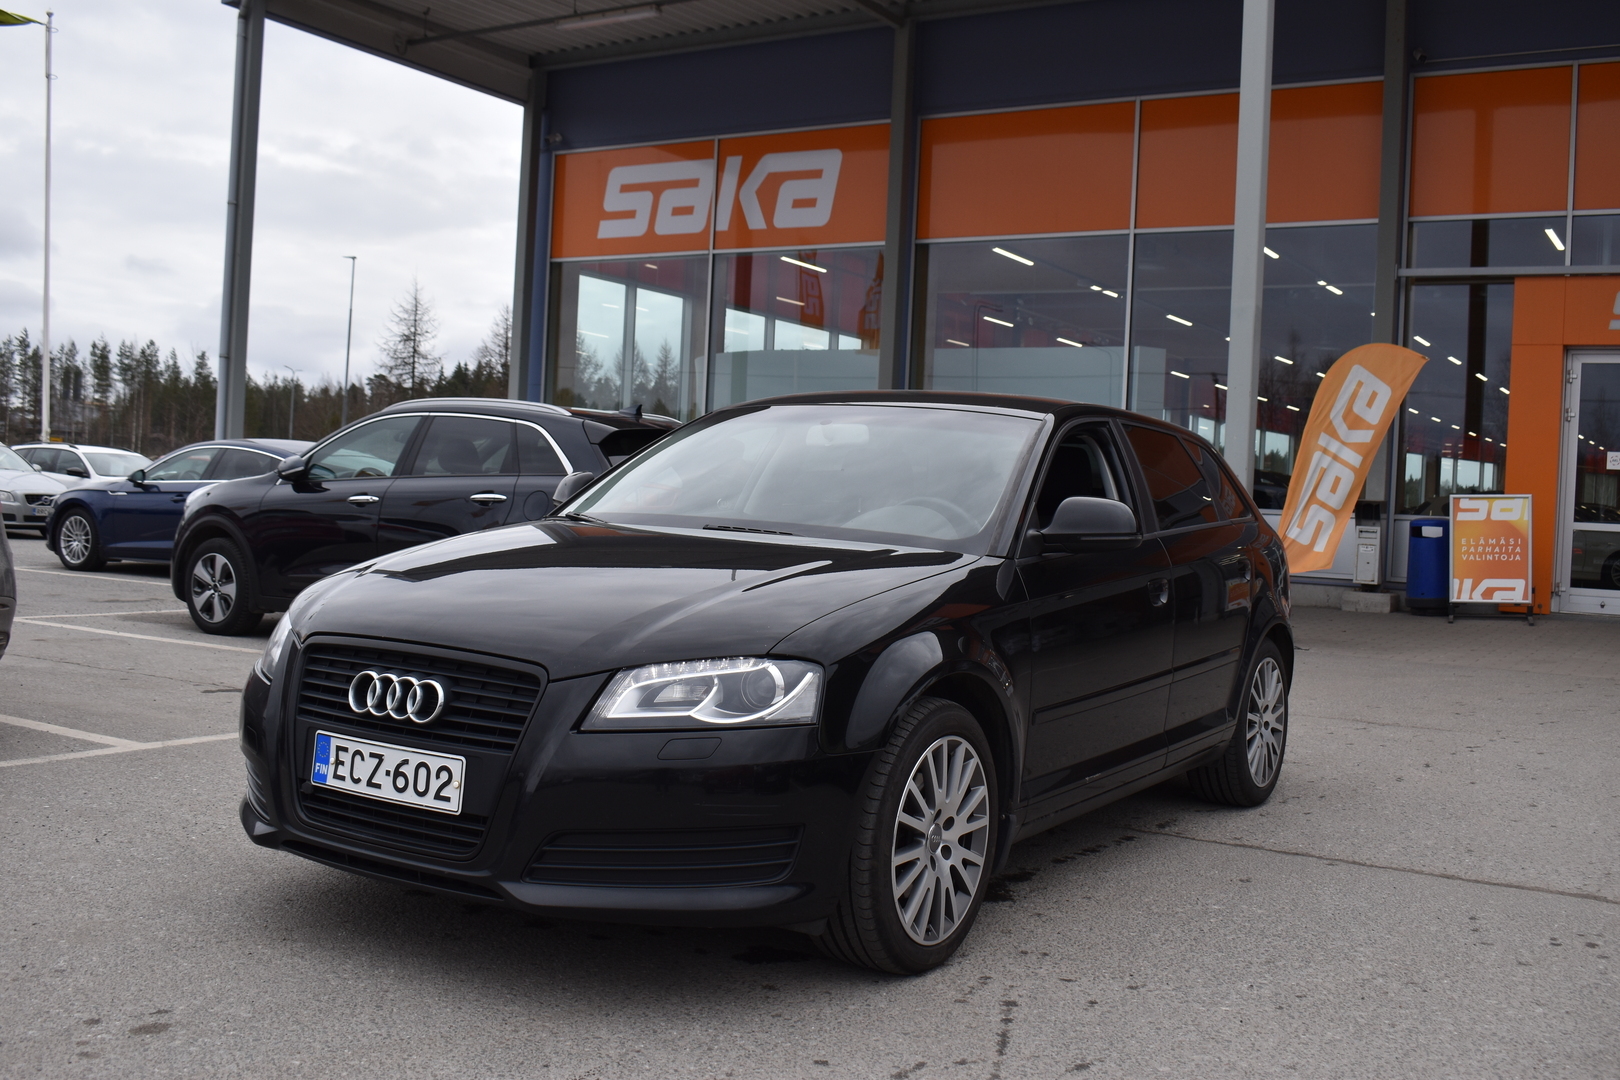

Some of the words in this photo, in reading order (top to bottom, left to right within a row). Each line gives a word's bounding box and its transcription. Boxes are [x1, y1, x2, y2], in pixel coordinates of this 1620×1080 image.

[1461, 537, 1521, 545] ELÄMÄSI
[314, 762, 329, 775] FIN
[333, 744, 453, 802] ECZ-602
